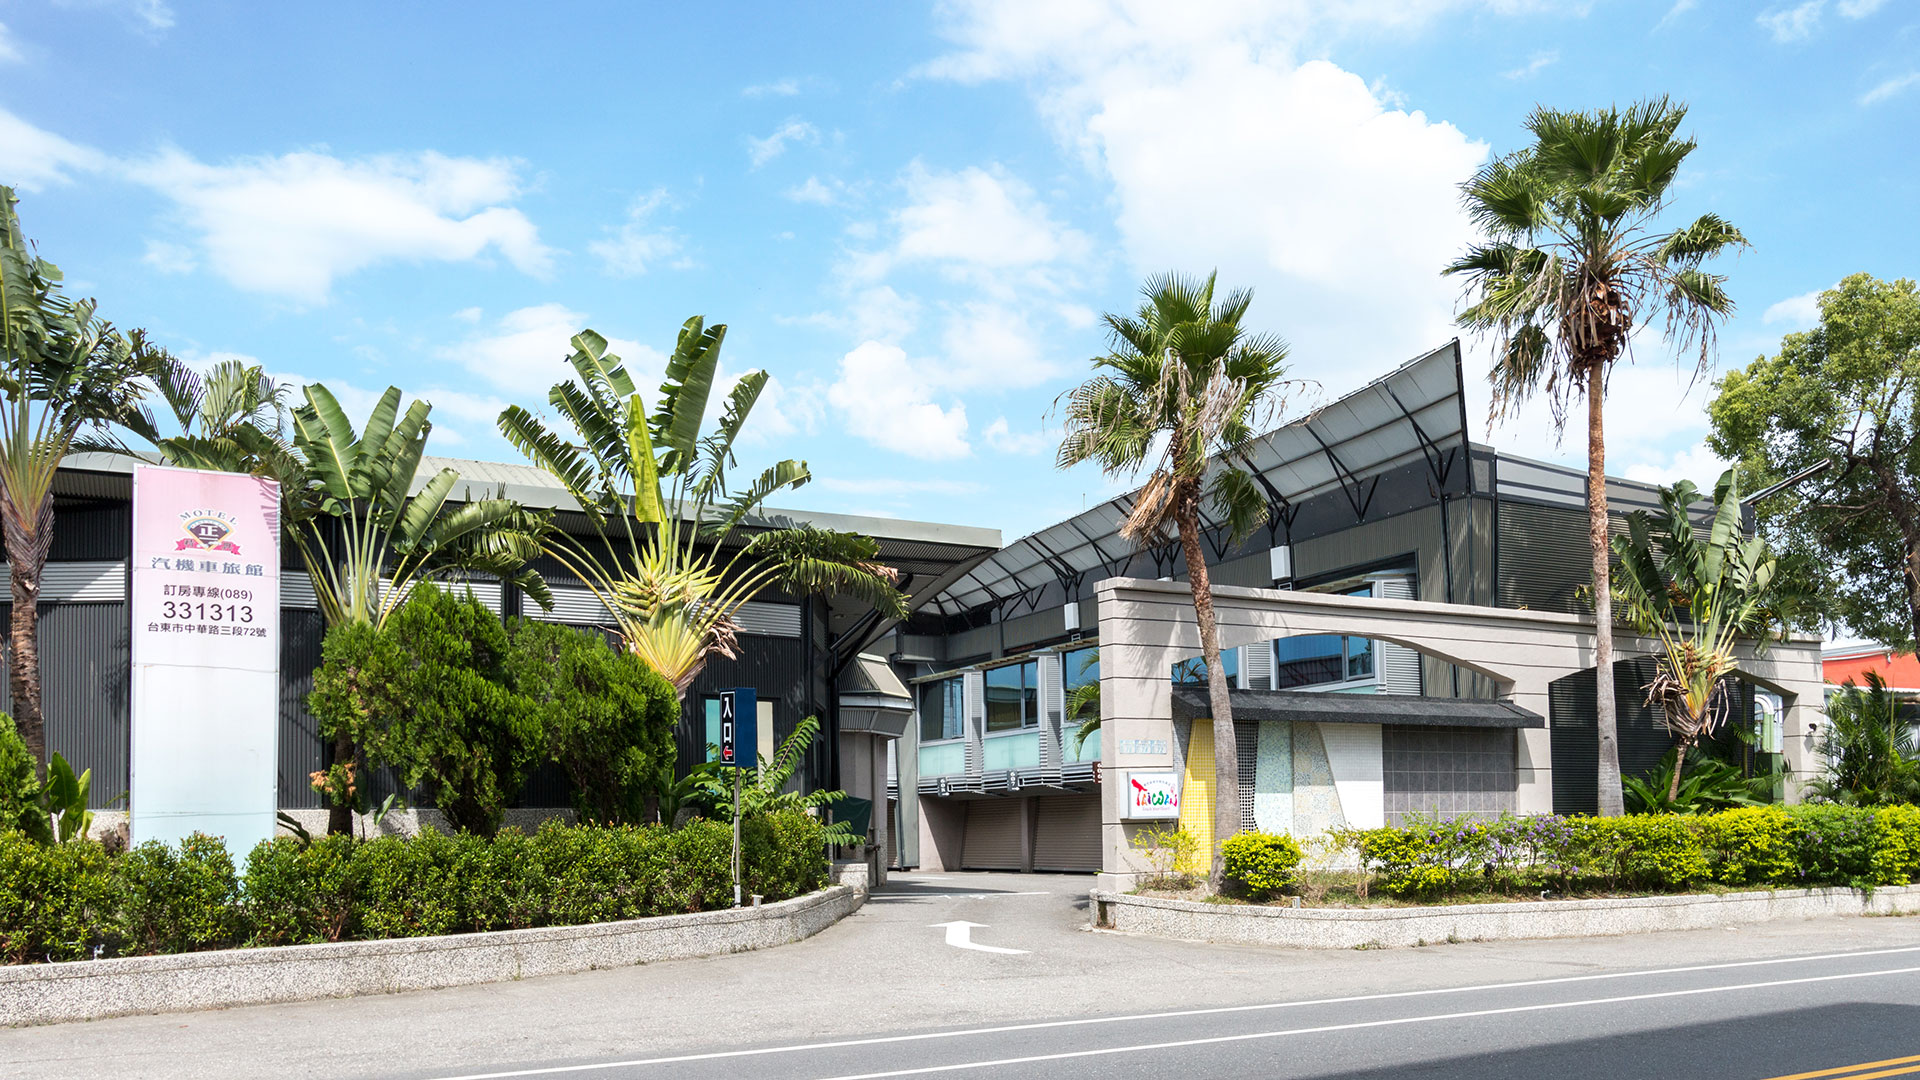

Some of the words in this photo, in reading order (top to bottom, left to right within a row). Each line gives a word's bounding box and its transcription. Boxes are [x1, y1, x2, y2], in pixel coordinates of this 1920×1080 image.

[180, 510, 237, 525] MOTEL
[151, 557, 263, 577] 汽機車旅館
[163, 584, 253, 601] 訂房專線(089)
[163, 601, 253, 623] 331313
[147, 622, 267, 637] 台東市中華路三段72號
[723, 697, 732, 743] 入口
